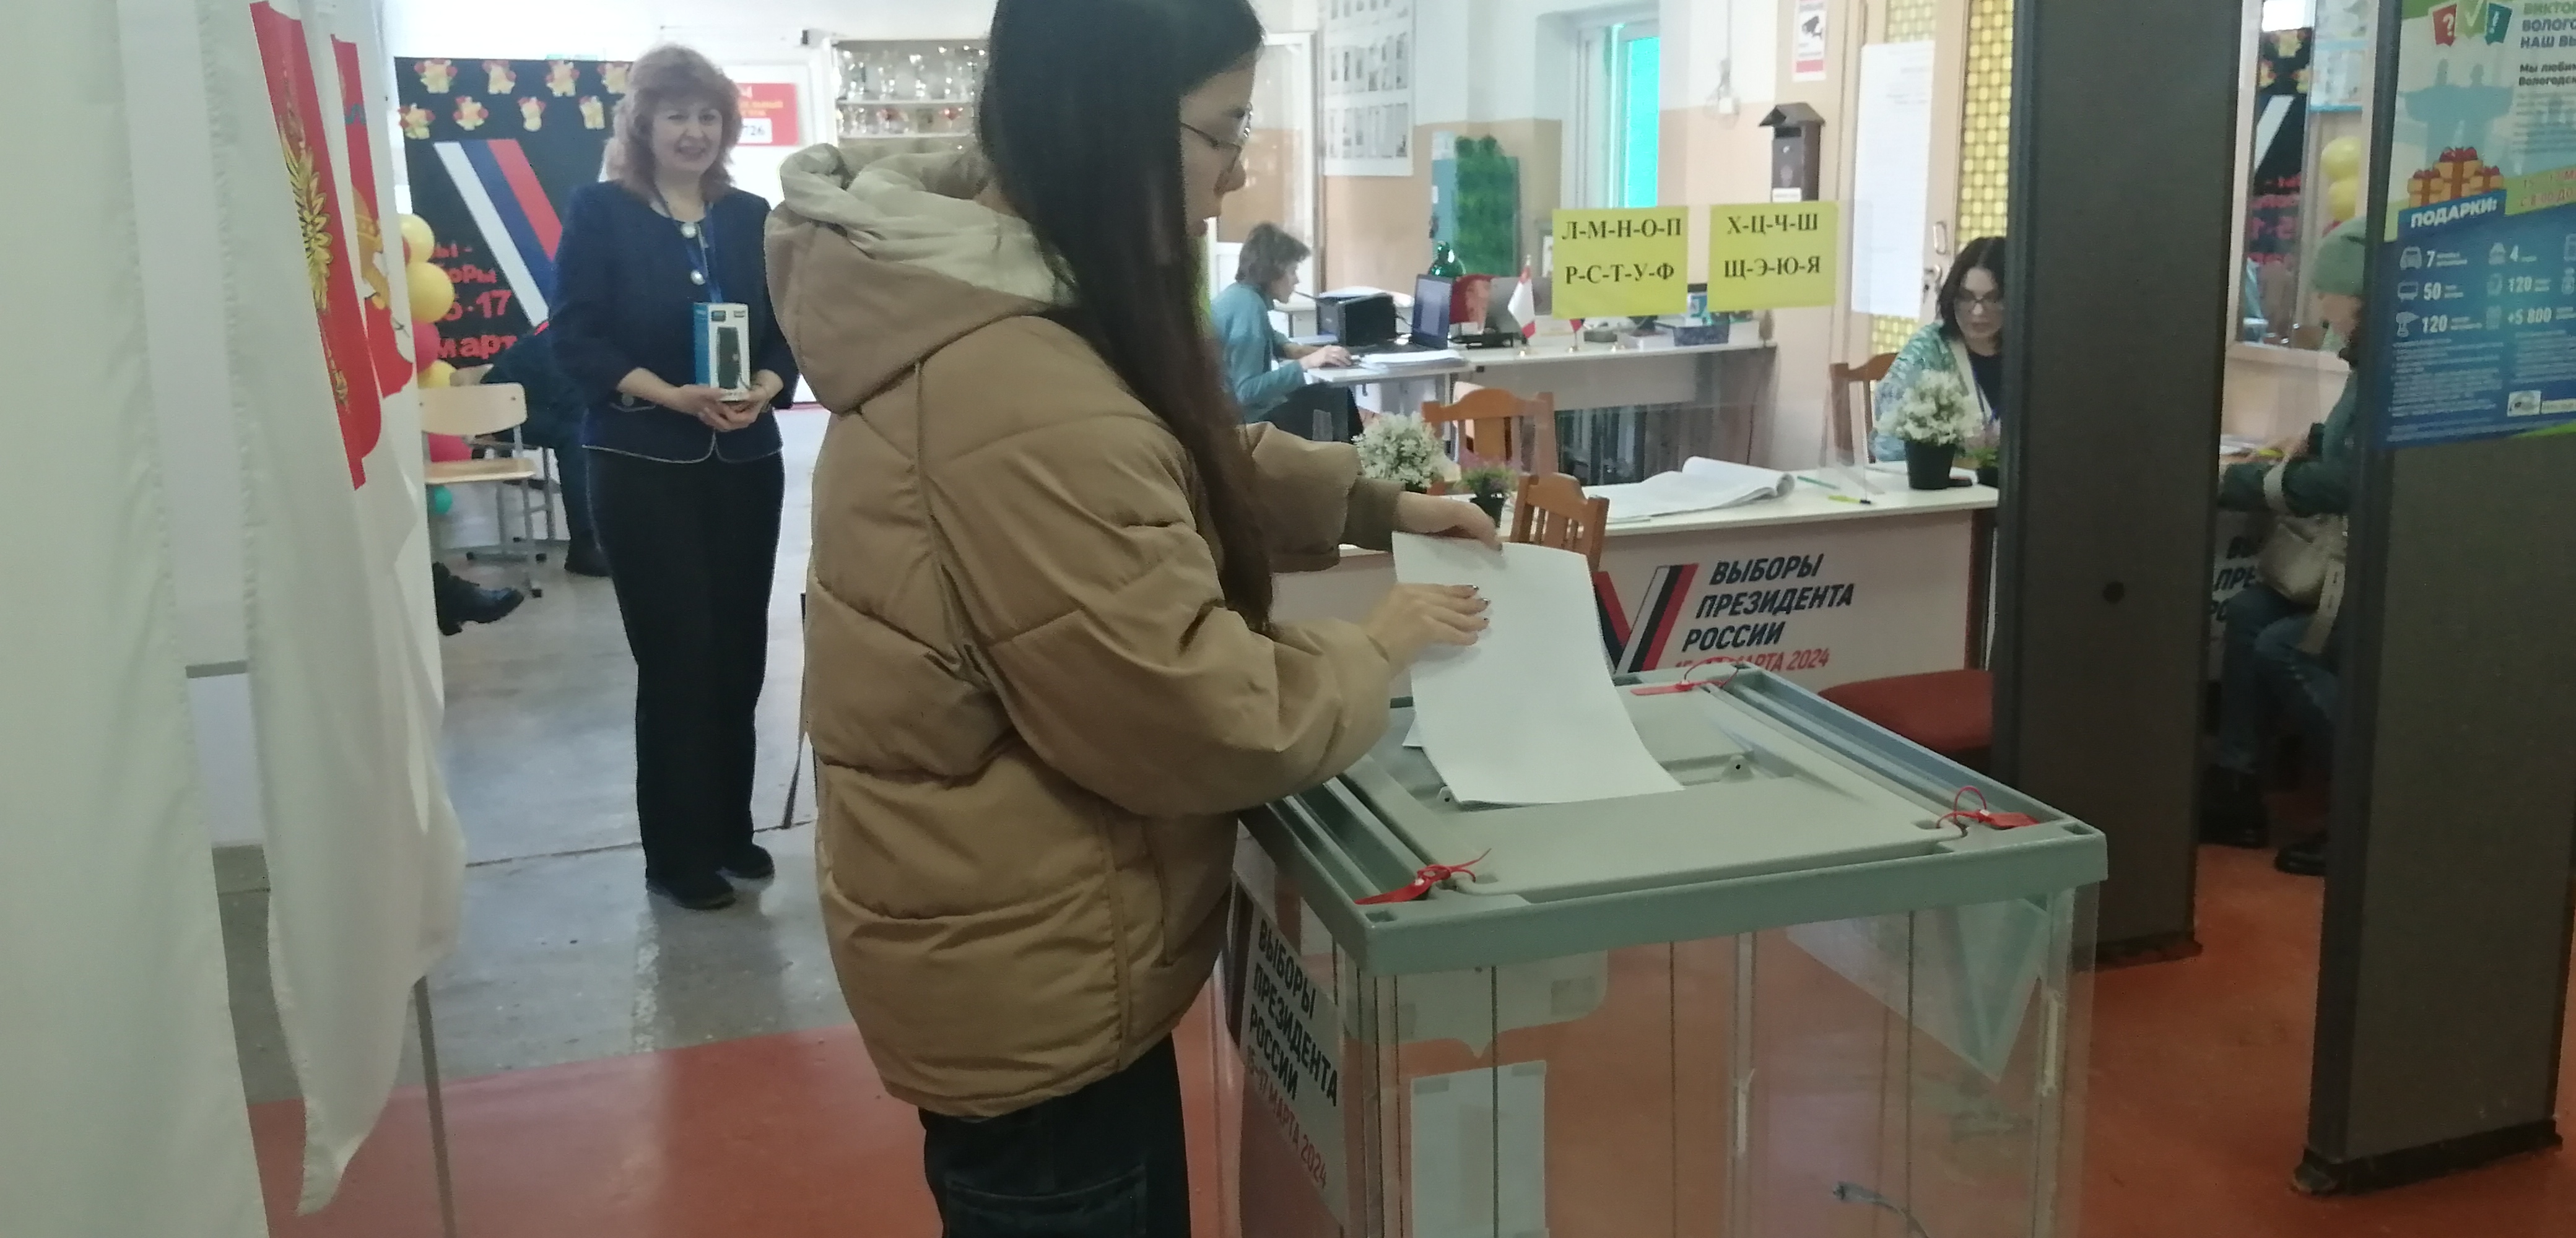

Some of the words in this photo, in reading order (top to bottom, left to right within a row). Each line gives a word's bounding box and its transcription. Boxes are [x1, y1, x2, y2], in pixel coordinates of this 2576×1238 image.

[2520, 36, 2554, 48] НАШ
[1726, 213, 1819, 235] Х-Ц-Ч-Ш
[2411, 197, 2497, 228] ПОДАРКИ:
[1561, 218, 1681, 240] Л-М-Н-О-П
[1723, 255, 1821, 280] Щ-Э-Ю-Я
[2426, 249, 2436, 268] 7
[1565, 262, 1675, 285] Р-С-Т-У-Ф
[2508, 275, 2533, 293] 120
[2423, 282, 2442, 301] 50
[2422, 314, 2448, 334] 120
[1708, 552, 1825, 586] ВЫБОРЫ
[1695, 582, 1855, 620] ПРЕЗИДЕНТА
[1681, 620, 1786, 652] РОССИИ
[1786, 647, 1830, 671] 2024
[1258, 917, 1316, 1021] ВЫБОРЫ
[1253, 961, 1338, 1107] ПРЕЗИДЕНТА
[1249, 1003, 1299, 1101] РОССИИ
[1300, 1133, 1327, 1189] 2024
